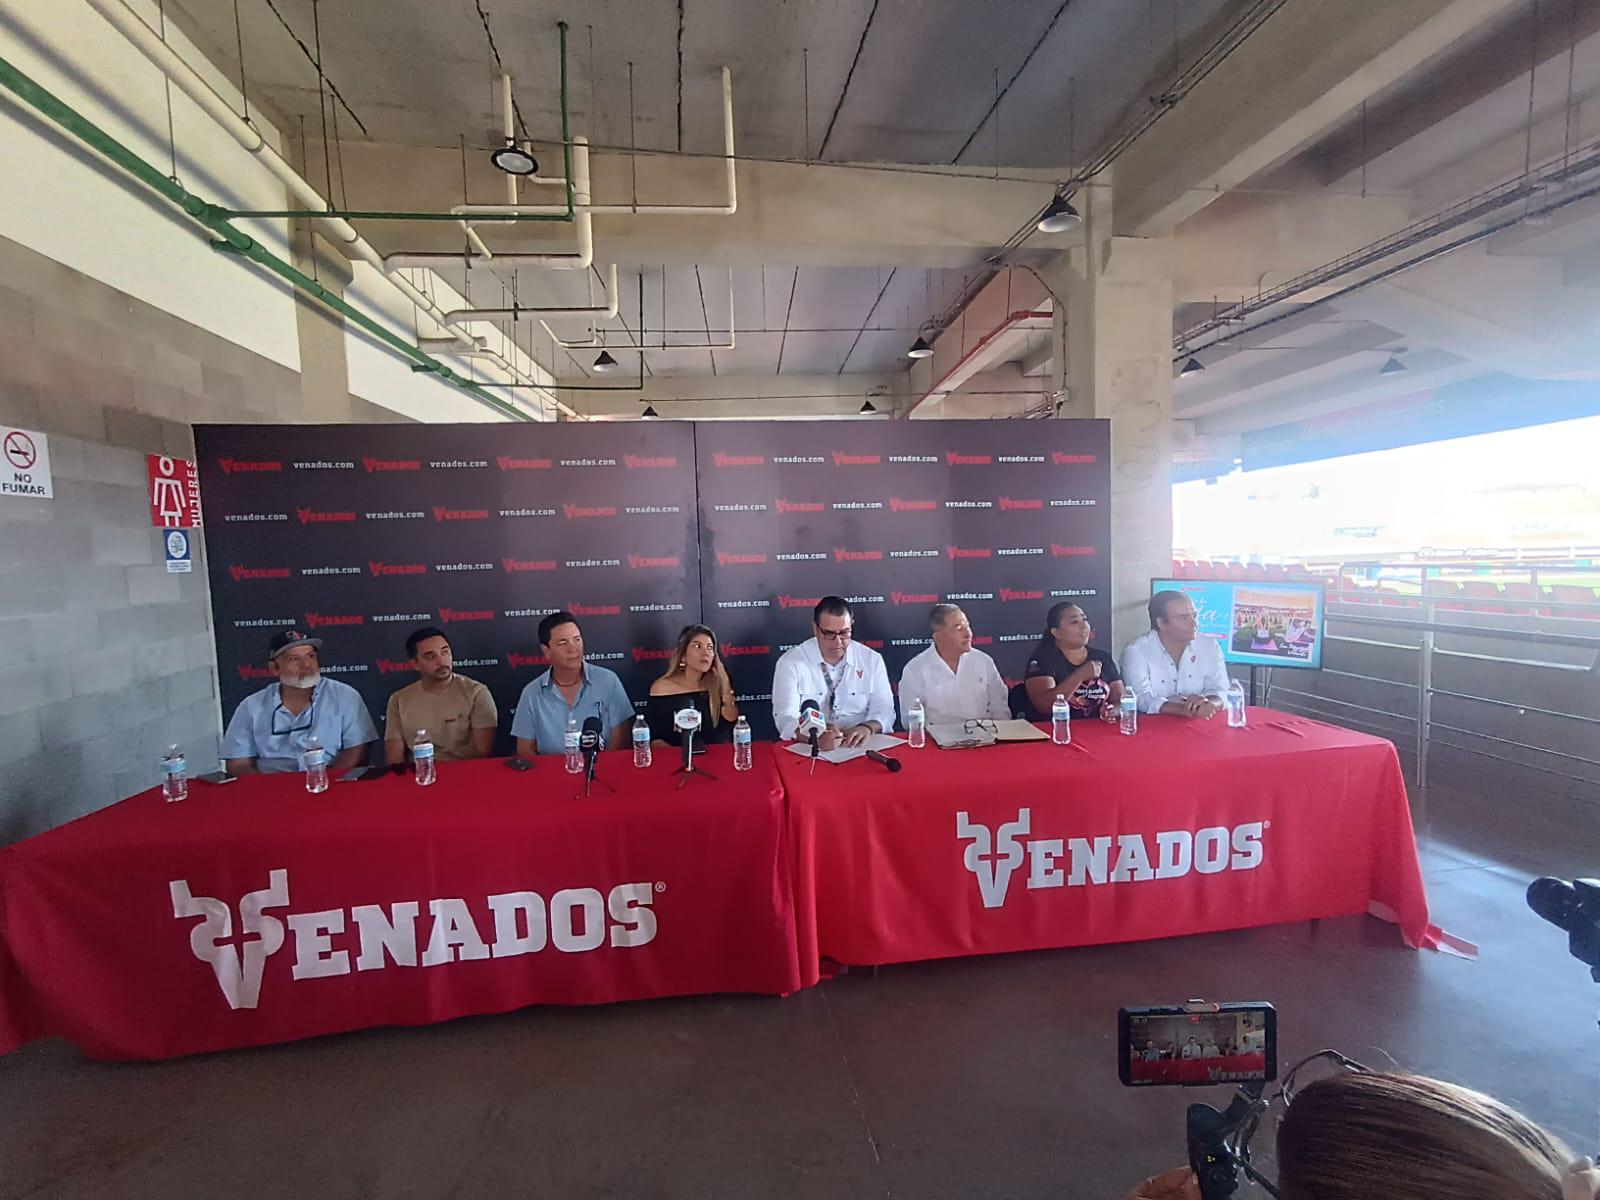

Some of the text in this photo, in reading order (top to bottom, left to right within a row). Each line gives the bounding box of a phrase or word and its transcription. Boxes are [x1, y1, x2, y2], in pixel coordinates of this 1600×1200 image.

[293, 460, 355, 469] venados.com
[430, 459, 488, 468] venados.com
[560, 458, 616, 466] venados.com
[773, 455, 825, 463] venados.com
[889, 455, 938, 463] venados.com
[998, 455, 1045, 463] venados.com
[14, 473, 32, 483] NO
[2, 483, 46, 495] FUMAR
[186, 460, 202, 528] MUJERES
[714, 503, 767, 511] venados.com
[832, 501, 883, 509] venados.com
[945, 500, 992, 508] venados.com
[1050, 499, 1096, 507] venados.com
[224, 512, 288, 522] venados.com
[365, 510, 425, 520] venados.com
[499, 507, 556, 517] venados.com
[625, 506, 680, 514] venados.com
[776, 552, 827, 560] venados.com
[890, 549, 939, 557] venados.com
[302, 566, 361, 575] venados.com
[436, 562, 493, 571] venados.com
[565, 559, 621, 567] venados.com
[718, 600, 770, 608] venados.com
[947, 592, 993, 600] venados.com
[1050, 588, 1096, 596] venados.com
[234, 617, 296, 627] venados.com
[372, 613, 431, 622] venados.com
[630, 603, 683, 612] venados.com
[892, 638, 934, 646] venados.co
[453, 658, 498, 667] nados.com
[956, 808, 1264, 908] VENADOS
[169, 868, 658, 1009] VENADOS
